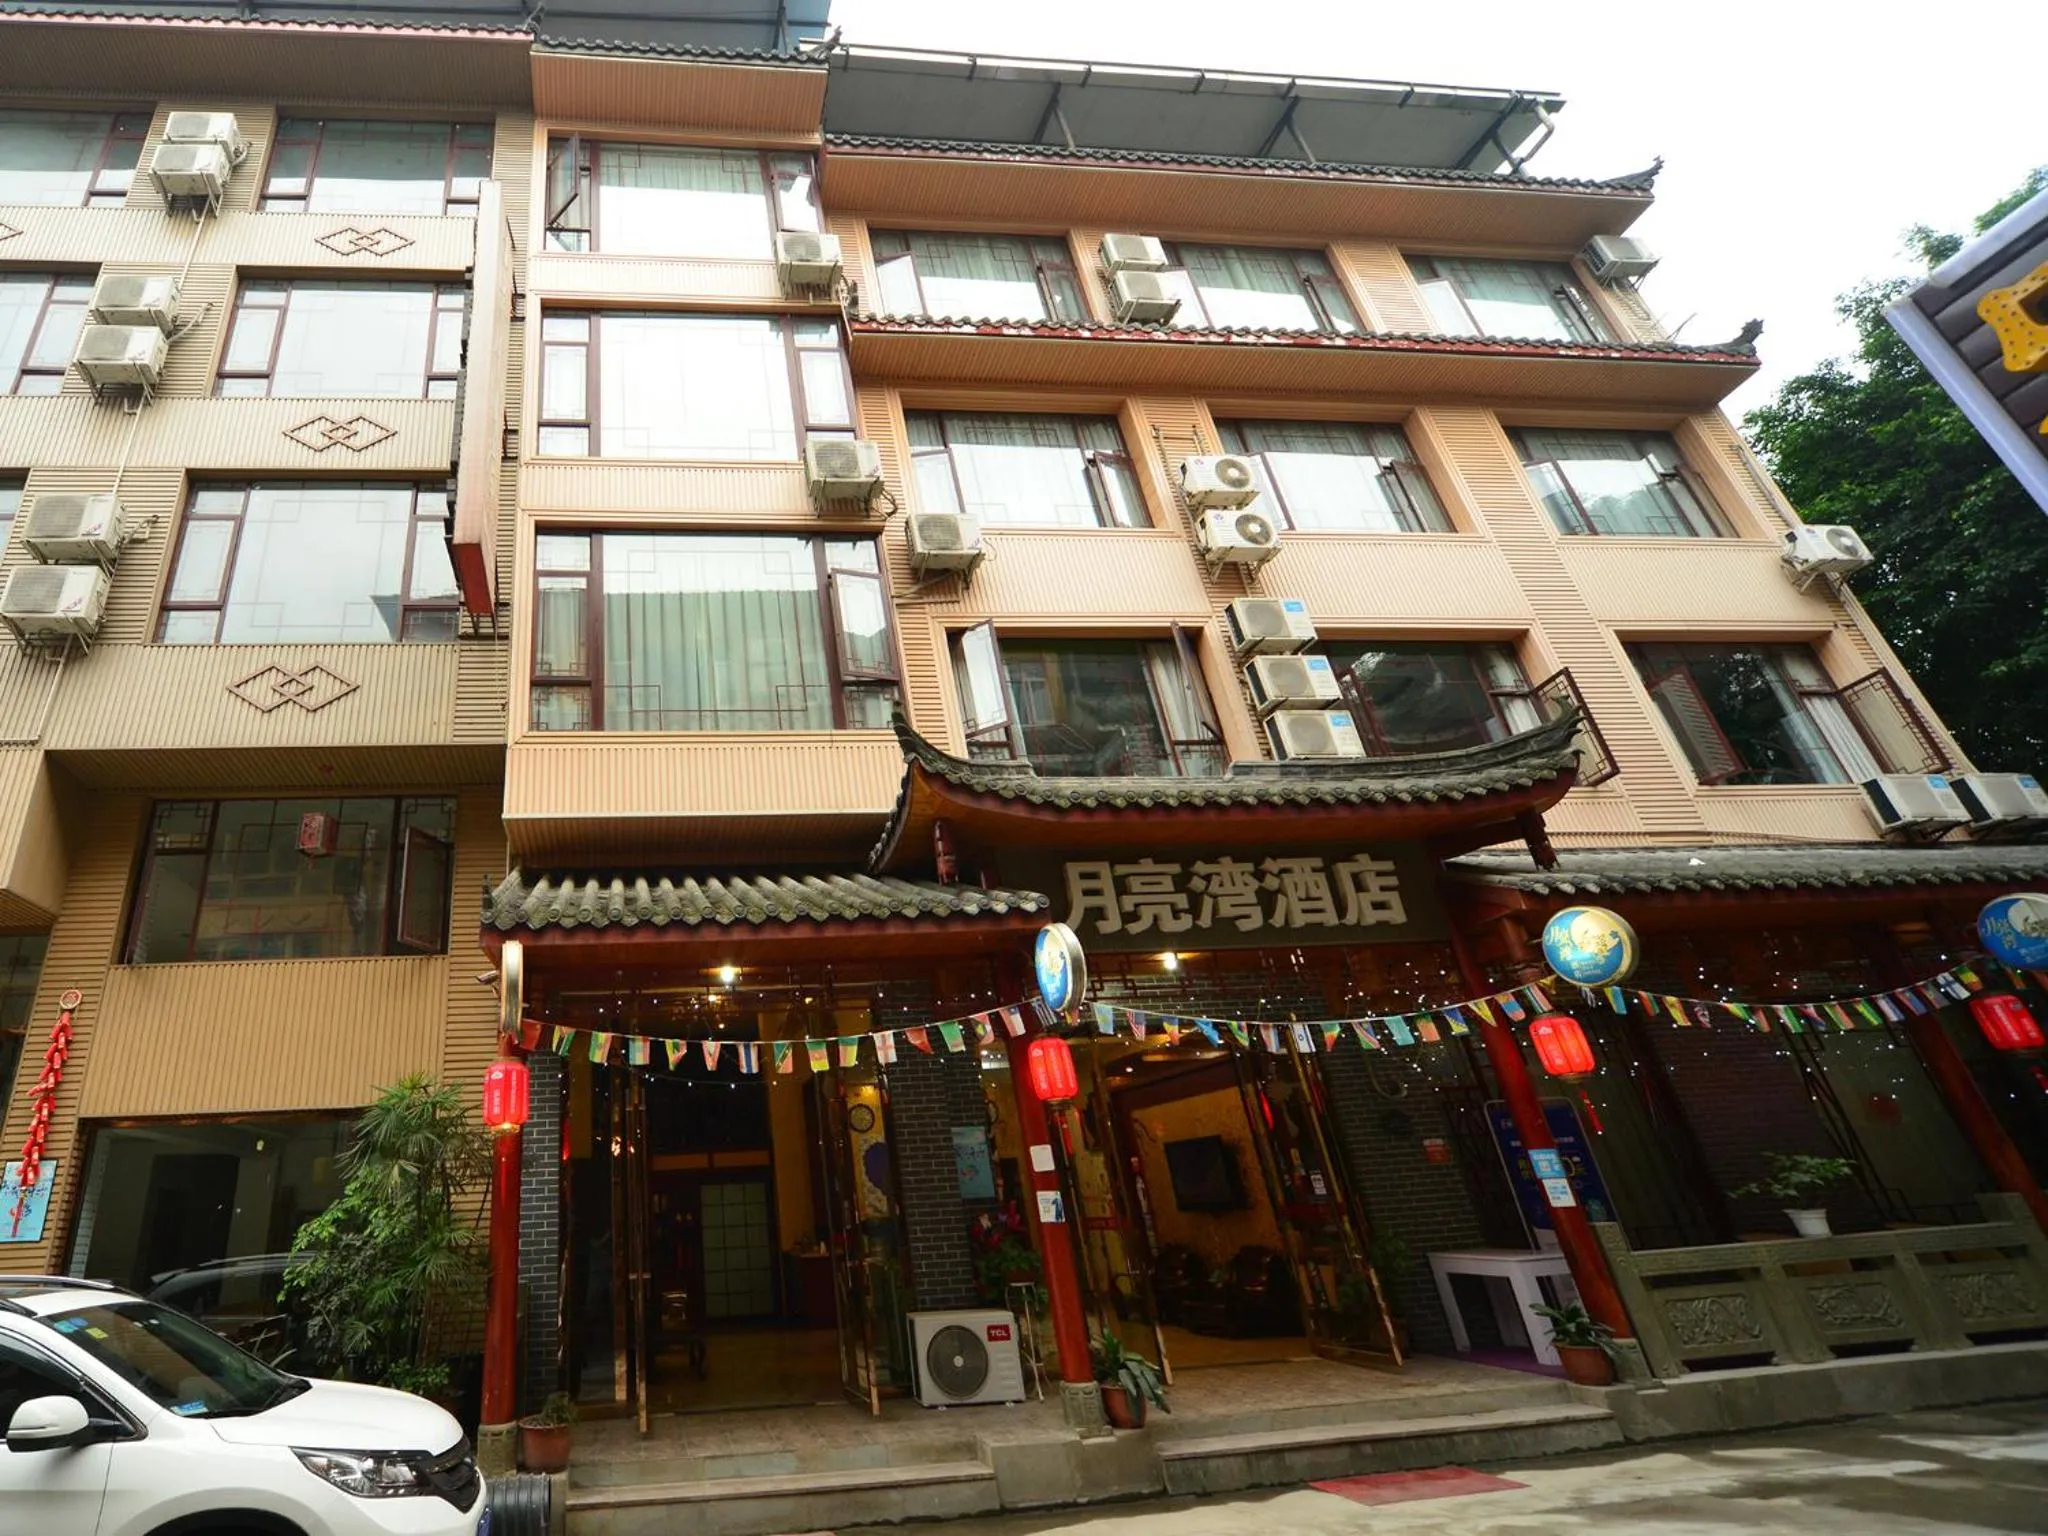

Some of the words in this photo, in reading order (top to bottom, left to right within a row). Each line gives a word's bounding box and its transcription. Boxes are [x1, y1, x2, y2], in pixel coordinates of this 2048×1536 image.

[1064, 854, 1407, 934] 月亮湾酒店
